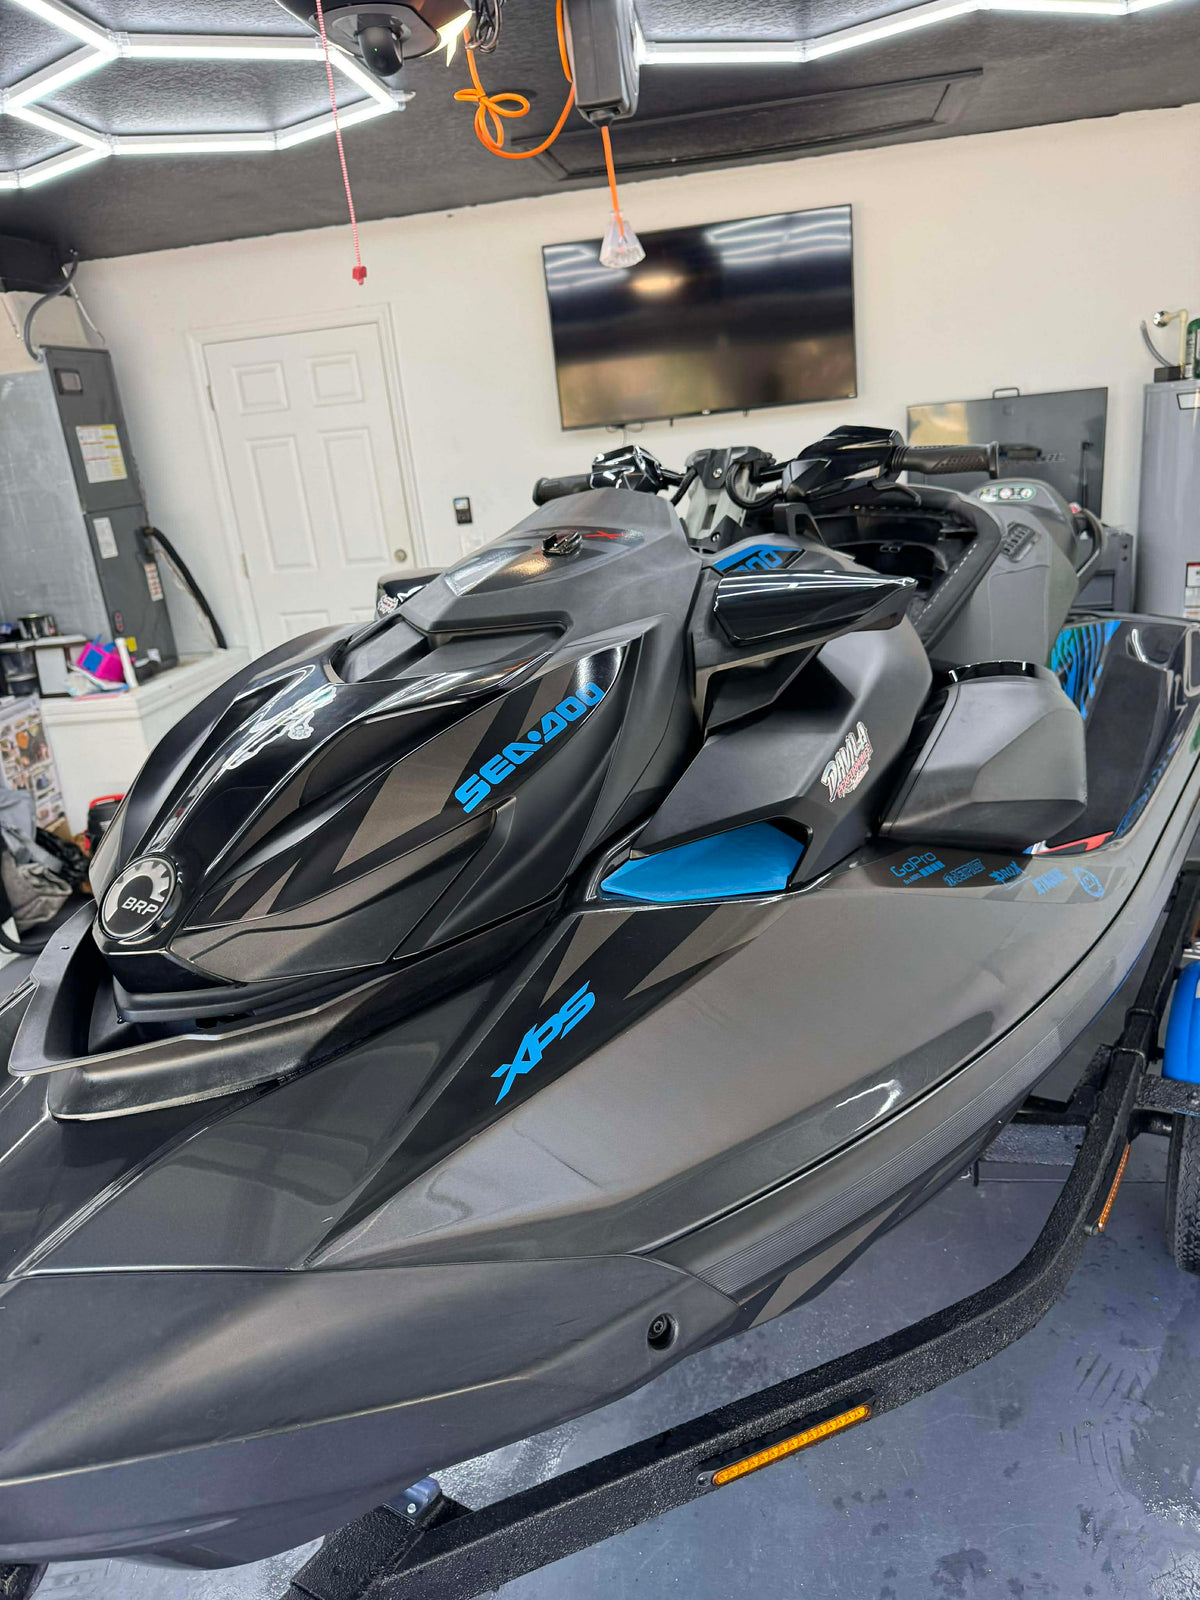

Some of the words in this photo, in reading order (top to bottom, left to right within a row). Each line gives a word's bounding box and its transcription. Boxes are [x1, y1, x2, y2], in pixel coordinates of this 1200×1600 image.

[821, 721, 869, 803] DAVILA
[890, 852, 936, 878] GoPro
[121, 896, 159, 915] BRP
[490, 980, 596, 1105] XPS
